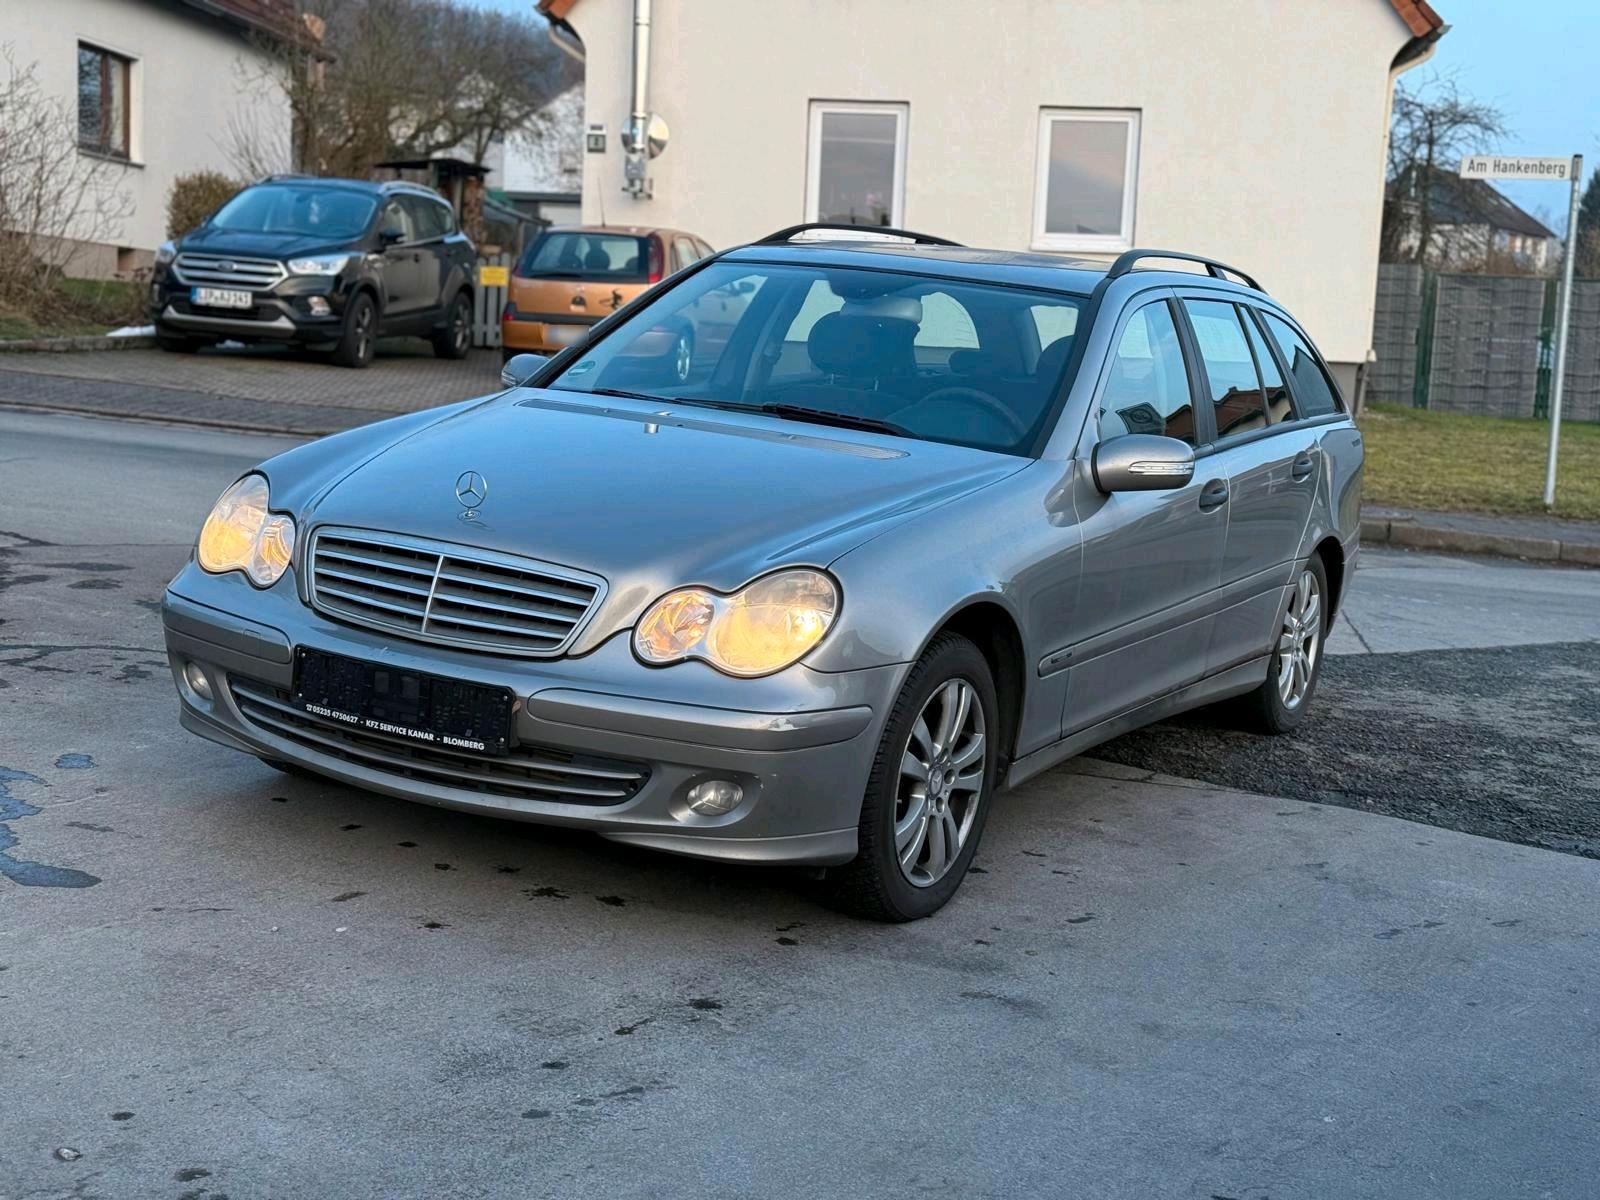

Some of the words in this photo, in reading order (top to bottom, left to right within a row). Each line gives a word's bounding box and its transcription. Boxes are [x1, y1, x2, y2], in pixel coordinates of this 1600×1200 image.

[1467, 159, 1487, 173] Am
[1493, 159, 1566, 178] Hankenberg
[312, 705, 331, 717] 05235
[332, 710, 358, 724] 4750627
[365, 719, 379, 729] KFZ
[379, 722, 407, 735] SERVICE
[407, 729, 434, 741] KANAR
[443, 736, 485, 750] BLOMBERG
